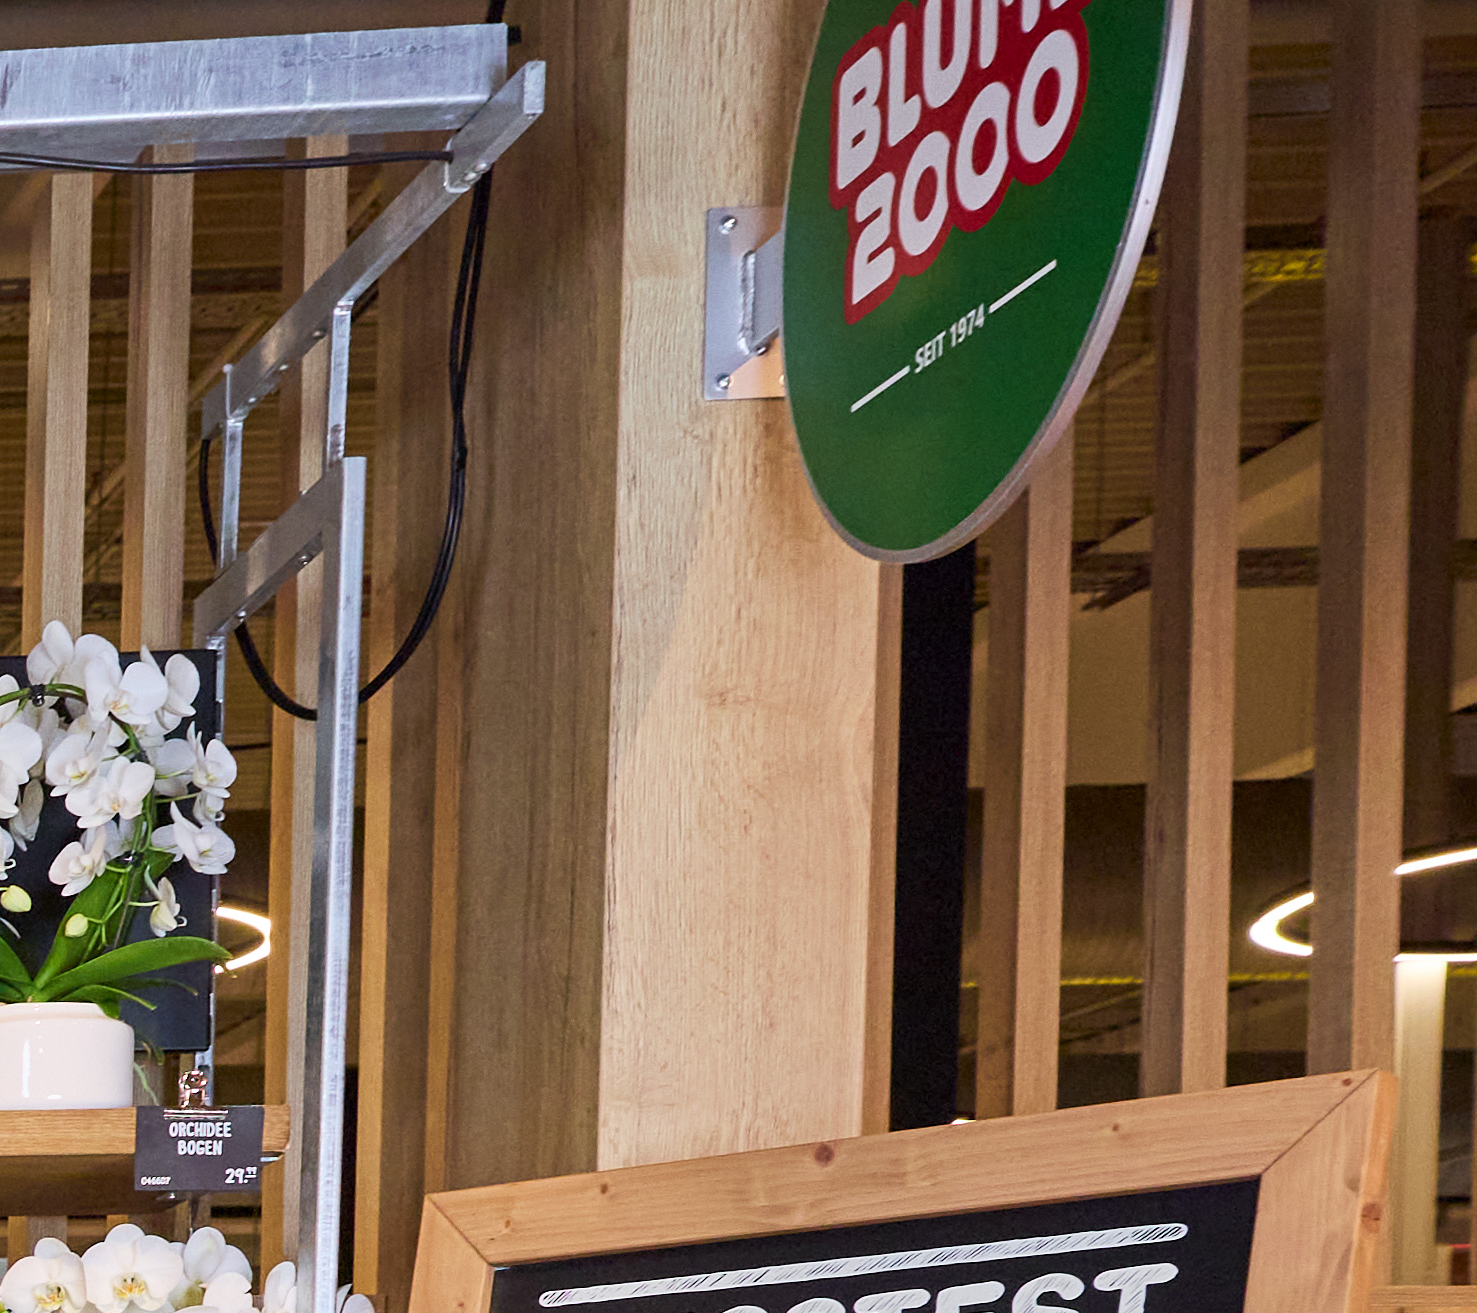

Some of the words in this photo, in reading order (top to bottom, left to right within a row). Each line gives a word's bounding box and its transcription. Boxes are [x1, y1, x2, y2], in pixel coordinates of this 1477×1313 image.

[852, 29, 1079, 305] 2000
[914, 330, 946, 373] SEIT
[949, 302, 986, 348] 1974
[168, 1121, 232, 1138] ORCHIDEE
[176, 1140, 223, 1156] BOGEN
